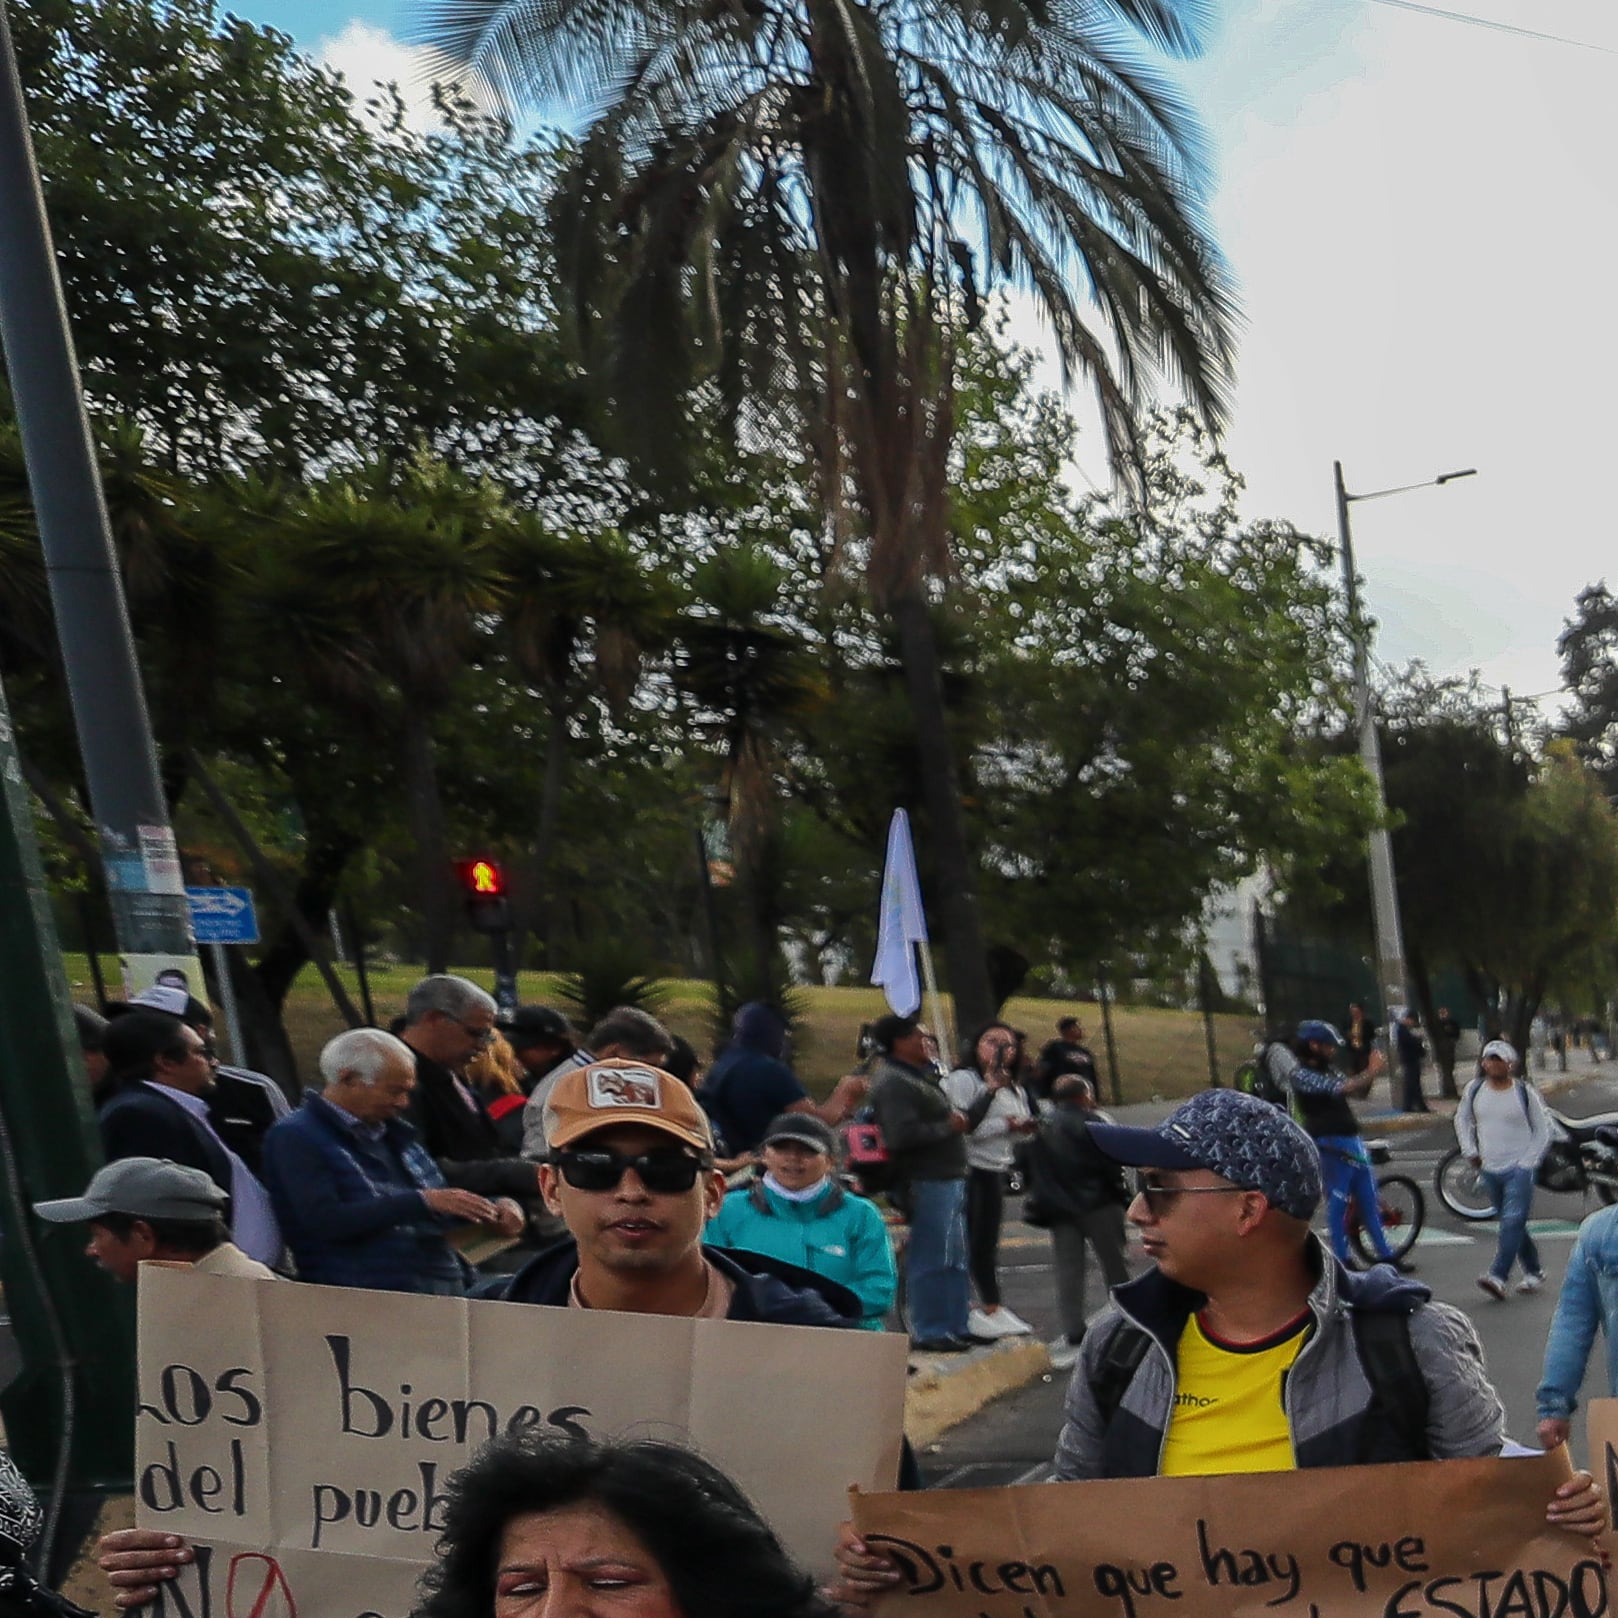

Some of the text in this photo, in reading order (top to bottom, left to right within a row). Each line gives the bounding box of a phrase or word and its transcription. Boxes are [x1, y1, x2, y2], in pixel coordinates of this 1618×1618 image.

[324, 1334, 594, 1441] bienes
[140, 1439, 246, 1518] del
[865, 1533, 1064, 1598] Dicen
[1198, 1519, 1302, 1605] hay
[1328, 1533, 1427, 1593] que
